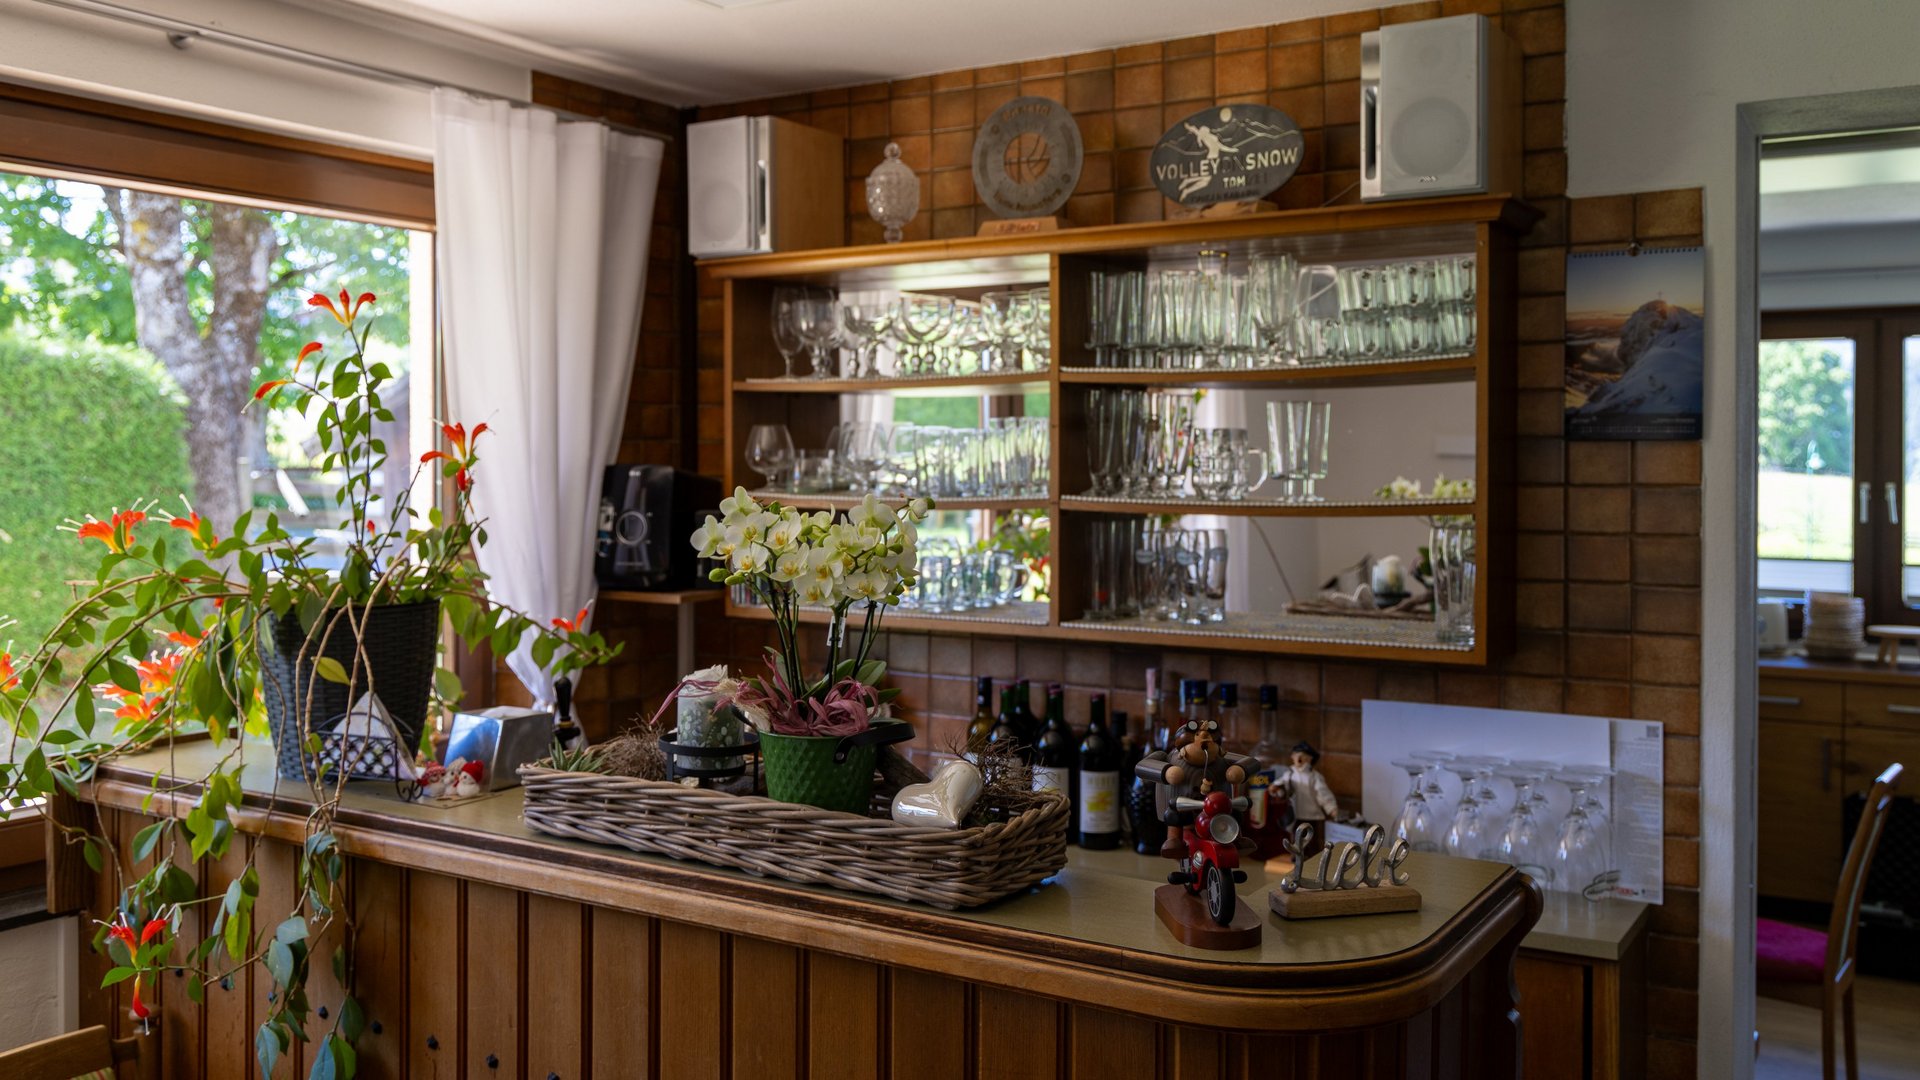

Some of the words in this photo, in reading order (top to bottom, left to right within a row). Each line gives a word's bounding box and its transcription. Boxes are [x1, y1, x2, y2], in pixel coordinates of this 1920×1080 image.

[1156, 158, 1221, 181] VOLLEY
[1245, 148, 1298, 171] SNOW
[1281, 822, 1410, 894] Liebe
